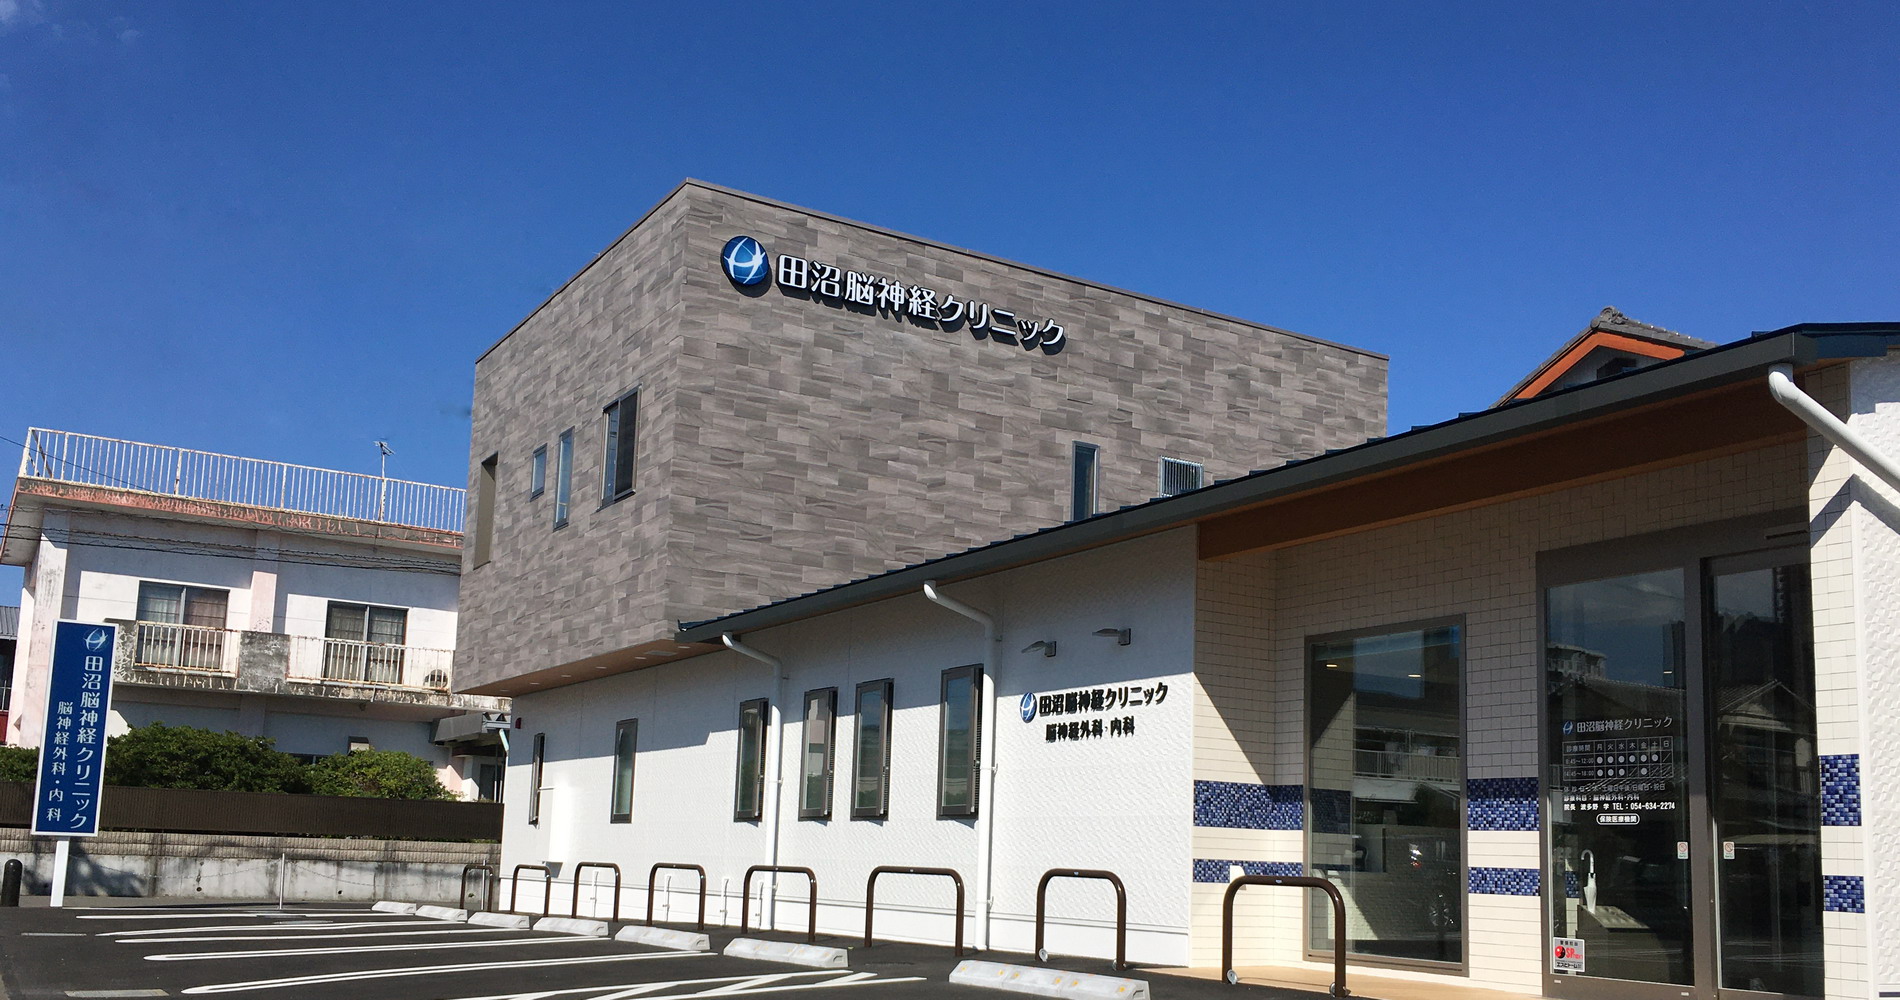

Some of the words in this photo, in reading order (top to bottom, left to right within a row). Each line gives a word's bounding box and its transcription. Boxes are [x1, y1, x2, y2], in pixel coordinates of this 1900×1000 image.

[777, 254, 1065, 346] 田沼脳神経クリニック
[1039, 682, 1168, 716] 田沼脳神経クリニック
[1045, 715, 1135, 742] 脳神経外科・内科
[1576, 716, 1673, 733] 田沼脳神経クリニック
[70, 655, 104, 829] 田沼脳神経クリニック
[1596, 743, 1603, 751] 月
[1607, 743, 1614, 751] 火
[1618, 742, 1625, 750] 水
[1629, 741, 1636, 749] 木
[1640, 741, 1647, 749] 金
[1652, 740, 1658, 748] 土
[1663, 740, 1669, 748] 日
[46, 701, 73, 822] 脳神経外科・内科
